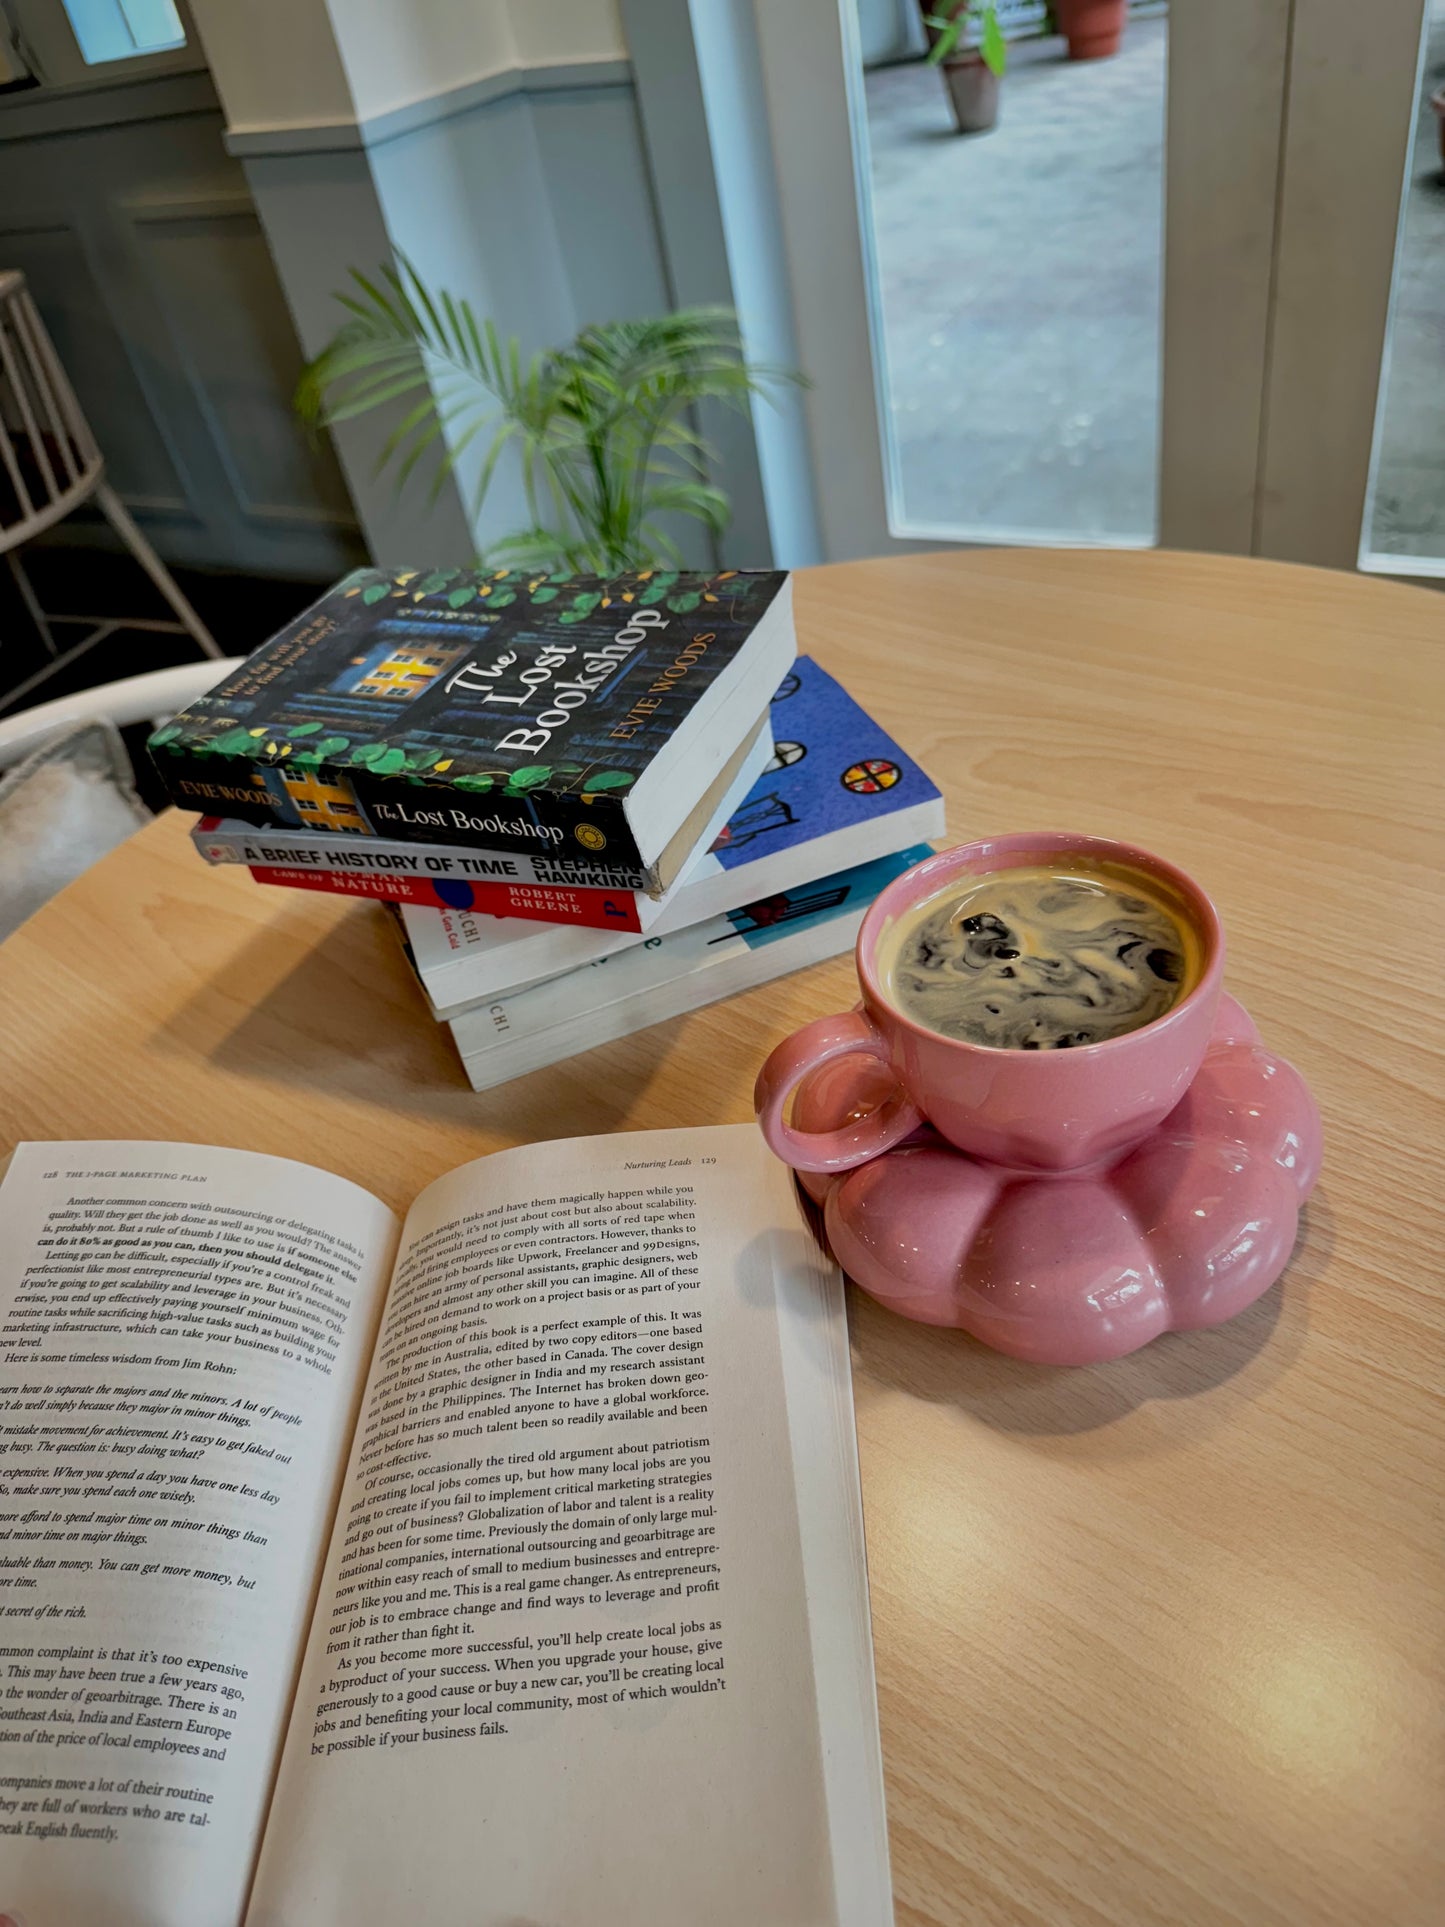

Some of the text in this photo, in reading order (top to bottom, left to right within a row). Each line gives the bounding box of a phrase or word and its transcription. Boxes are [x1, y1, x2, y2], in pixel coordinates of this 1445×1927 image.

[444, 650, 517, 694] The
[481, 644, 577, 707] Lost
[494, 609, 671, 755] Bookshop
[609, 631, 716, 740] EVIE WOODS
[179, 780, 283, 807] EVIE WOODS
[373, 803, 399, 820] The
[395, 803, 448, 827] Lost
[449, 808, 564, 845] Bookshop
[243, 848, 519, 876] A BRIEF HISTORY OF TIME
[533, 870, 645, 889] HAWKING
[331, 877, 414, 896] NATURE
[508, 886, 577, 903] ROBERT
[510, 898, 582, 914] GREENE
[457, 910, 481, 945] UCHI
[181, 1174, 207, 1182] PLAN
[624, 1160, 666, 1170] Nurturing
[668, 1157, 692, 1167] Leads
[55, 1237, 69, 1246] do
[69, 1237, 78, 1245] it
[79, 1237, 101, 1245] 80%
[113, 1237, 141, 1248] good
[152, 1241, 173, 1249] you
[174, 1242, 196, 1251] can,
[198, 1243, 223, 1254] then
[223, 1248, 244, 1257] you
[245, 1250, 282, 1266] should
[282, 1259, 325, 1280] delegate
[444, 1268, 460, 1281] job
[462, 1259, 494, 1275] boards
[497, 1256, 514, 1266] like
[518, 1249, 561, 1264] Upwork,
[565, 1246, 618, 1257] Freelancer
[621, 1241, 639, 1252] and
[643, 1239, 700, 1251] 99Designs,
[387, 1357, 400, 1369] The
[402, 1339, 453, 1364] production
[455, 1333, 467, 1344] of
[469, 1331, 488, 1342] this
[491, 1325, 517, 1338] book
[521, 1324, 529, 1334] is
[541, 1320, 579, 1334] perfect
[582, 1315, 627, 1328] example
[629, 1313, 642, 1324] of
[644, 1312, 667, 1323] this.
[670, 1311, 679, 1320] It
[682, 1311, 702, 1319] was
[4, 1353, 29, 1363] Here
[30, 1353, 39, 1362] is
[68, 1352, 110, 1363] timeless
[112, 1354, 152, 1365] wisdom
[154, 1355, 180, 1367] from
[181, 1358, 201, 1369] Jim
[3, 1424, 292, 1464] mistake movement for achievement. It's easy to get faked out
[365, 1437, 710, 1490] Of course, occasionally the tired old argument about patriotism
[13, 1484, 40, 1495] make
[39, 1487, 62, 1495] sure
[61, 1487, 81, 1498] you
[82, 1485, 114, 1498] spend
[113, 1486, 137, 1497] each
[138, 1490, 158, 1499] one
[160, 1490, 195, 1505] wisely.
[337, 1620, 722, 1670] As you become more successful, you'll help create local jobs as
[47, 1709, 75, 1723] Asia,
[78, 1710, 108, 1724] India
[110, 1712, 134, 1725] and
[135, 1713, 183, 1730] Eastern
[185, 1719, 232, 1741] Europe
[313, 1678, 726, 1738] jobs and benefiting your local community, most of which wouldn't
[311, 1721, 508, 1756] be possible if your business fails.
